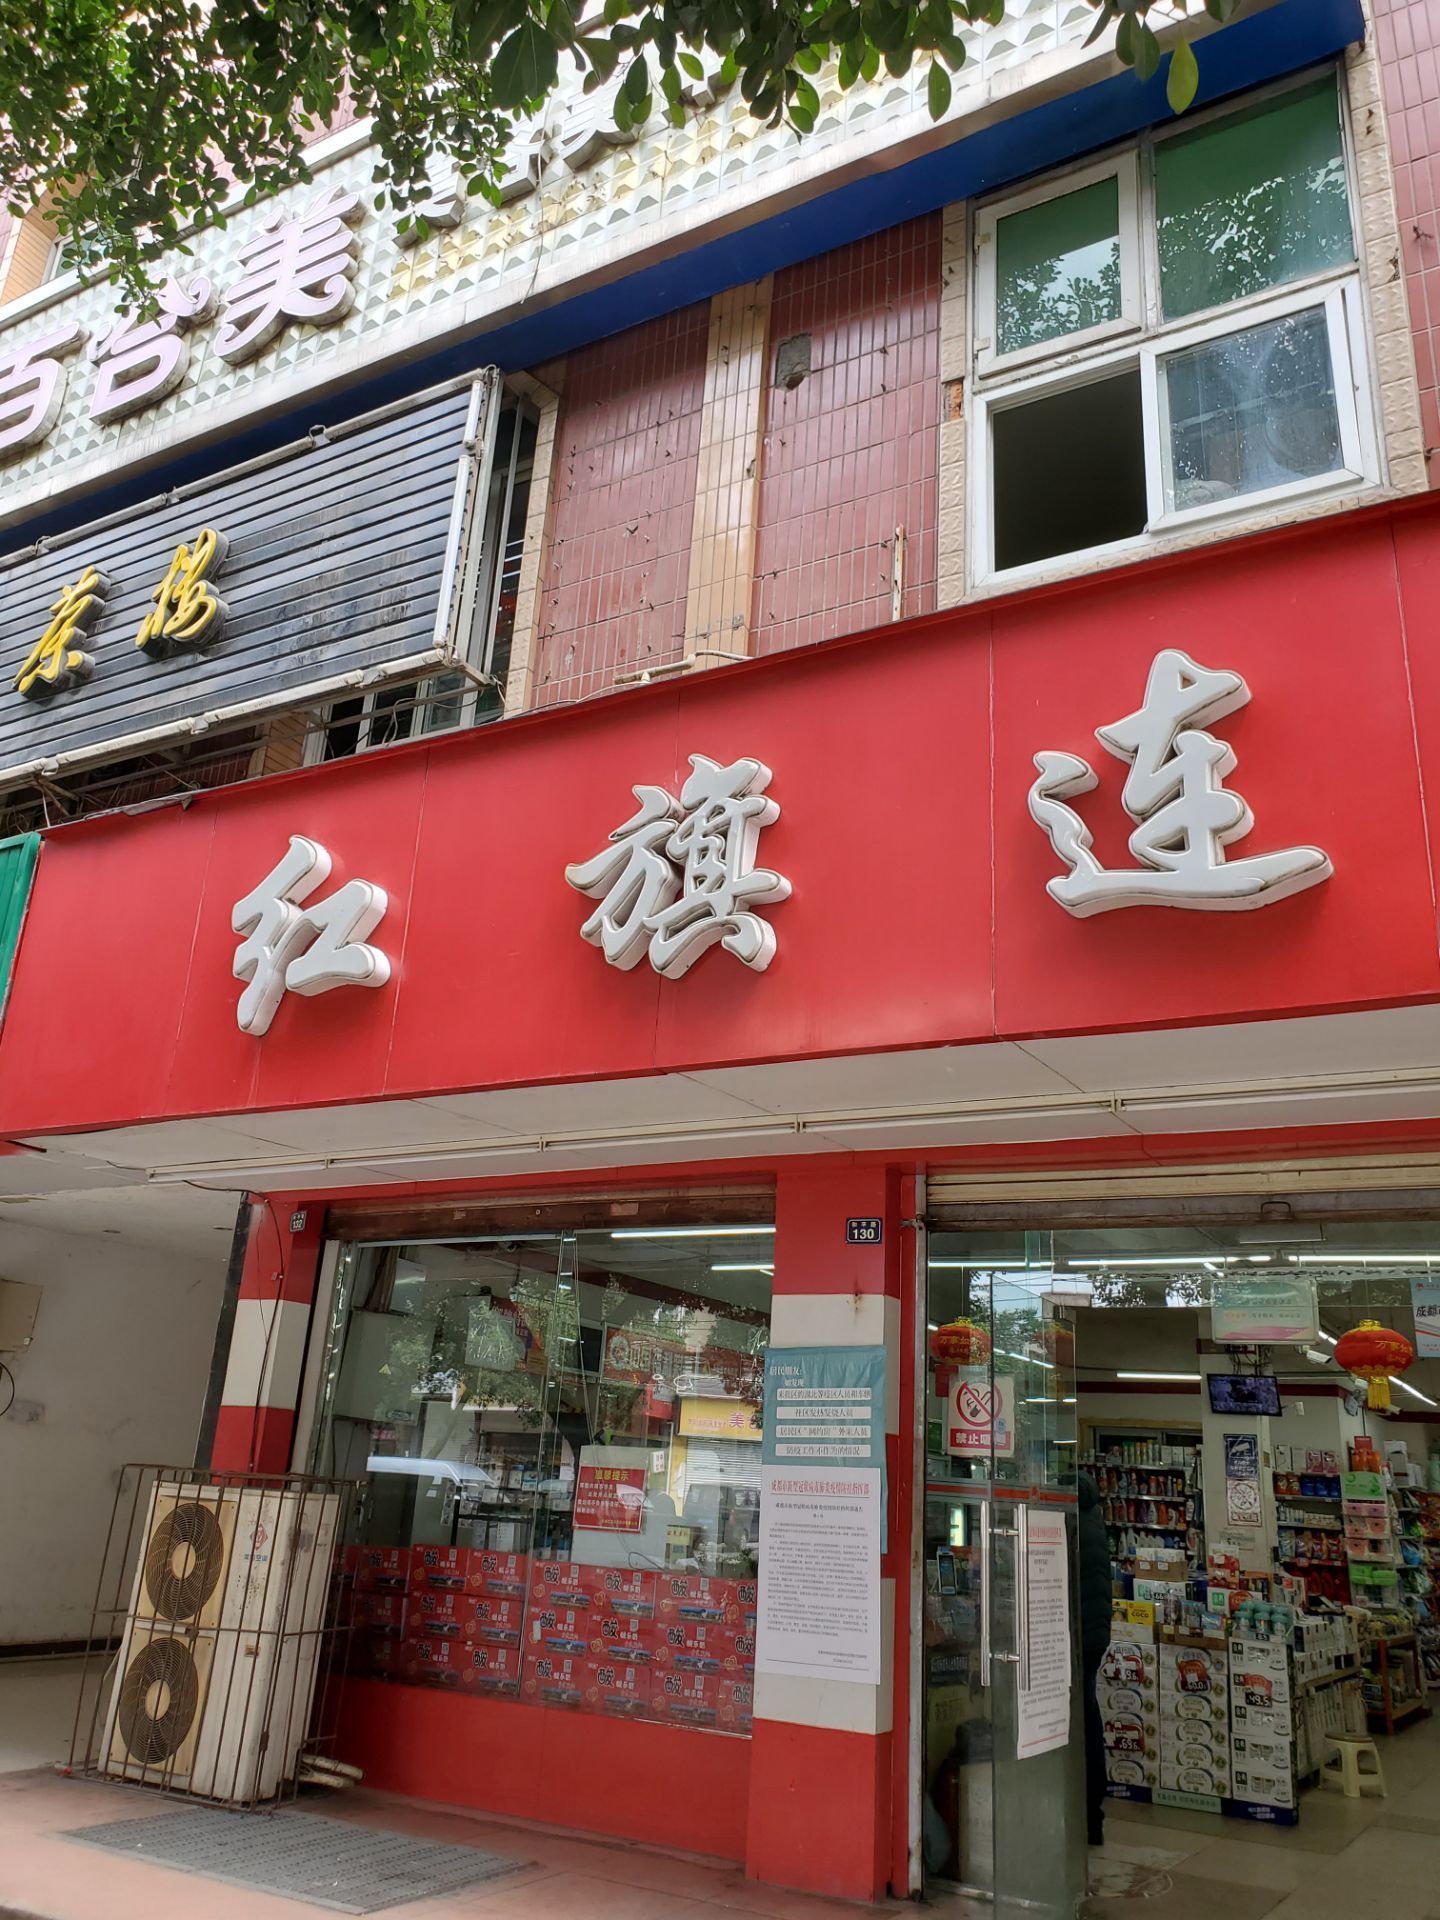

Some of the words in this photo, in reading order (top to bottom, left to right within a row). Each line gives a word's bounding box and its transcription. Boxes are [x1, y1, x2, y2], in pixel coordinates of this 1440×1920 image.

[231, 649, 1336, 1038] 红旗连
[852, 1229, 875, 1240] 130
[1416, 1305, 1440, 1318] 成都
